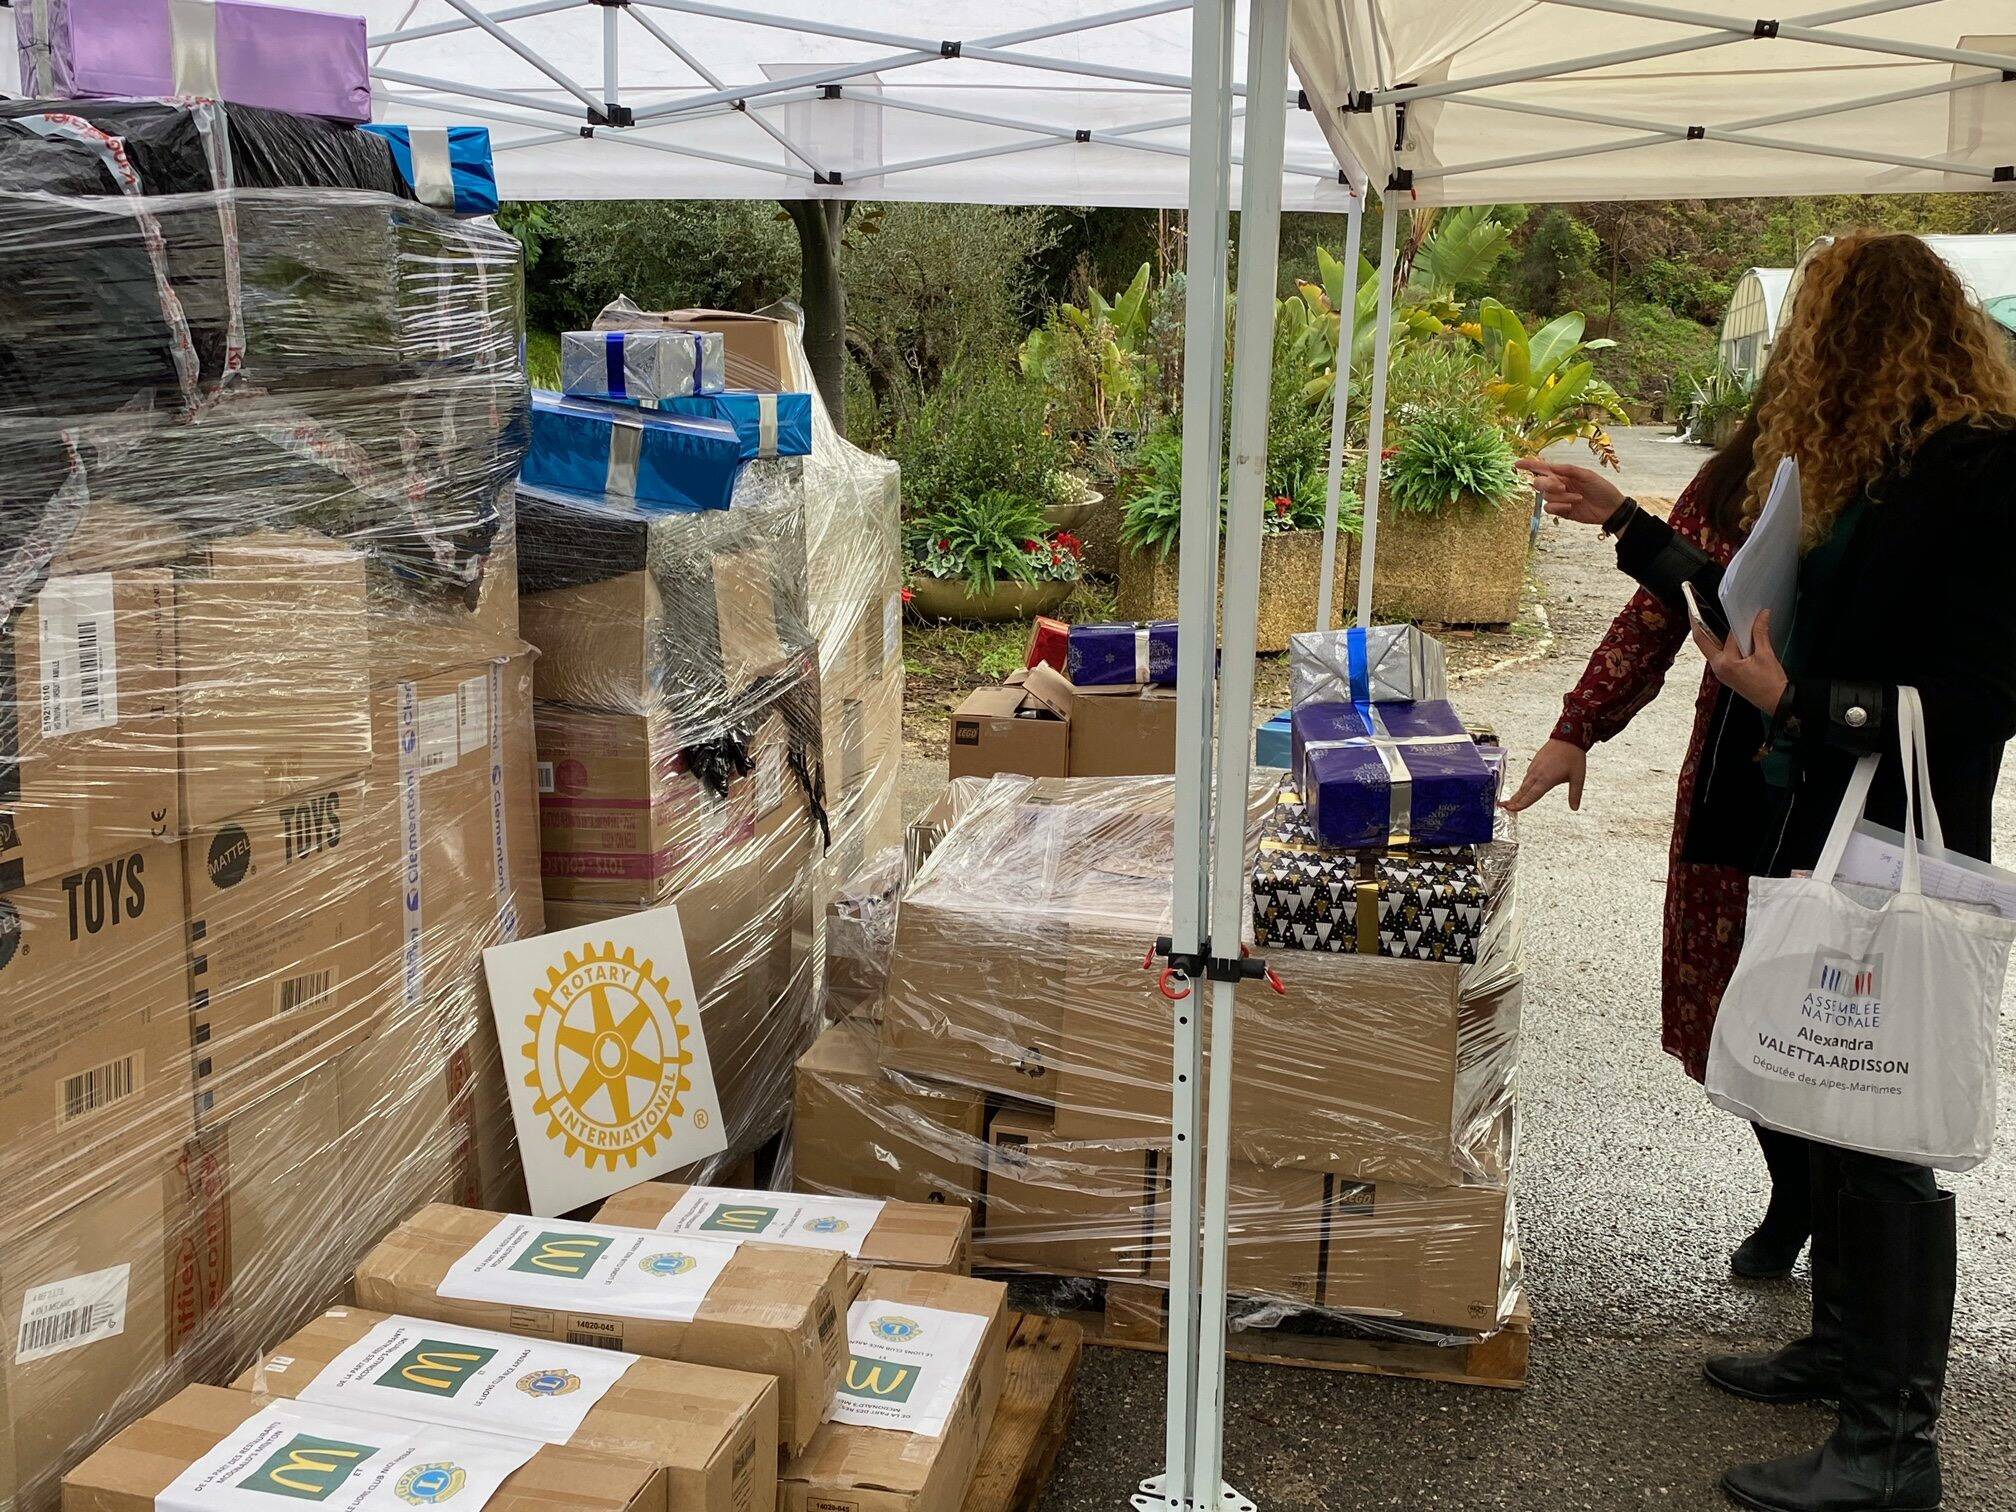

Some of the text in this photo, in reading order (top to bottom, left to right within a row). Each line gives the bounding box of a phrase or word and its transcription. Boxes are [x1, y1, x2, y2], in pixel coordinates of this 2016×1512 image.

[959, 728, 977, 738] LEGO
[279, 791, 341, 865] TOYS
[405, 770, 419, 883] Clementoni
[494, 790, 506, 894] Clementoni
[208, 837, 250, 874] MATTEL
[62, 853, 145, 941] TOYS
[560, 966, 630, 999] ROTARY
[1757, 1033, 1909, 1075] VALETTA-ARDISSON
[1797, 1026, 1874, 1051] Alexandra
[1753, 1055, 1796, 1080] Députée
[1798, 1073, 1817, 1087] des
[558, 1072, 676, 1147] INTERNATIONAL
[576, 1319, 615, 1332] 14020-045
